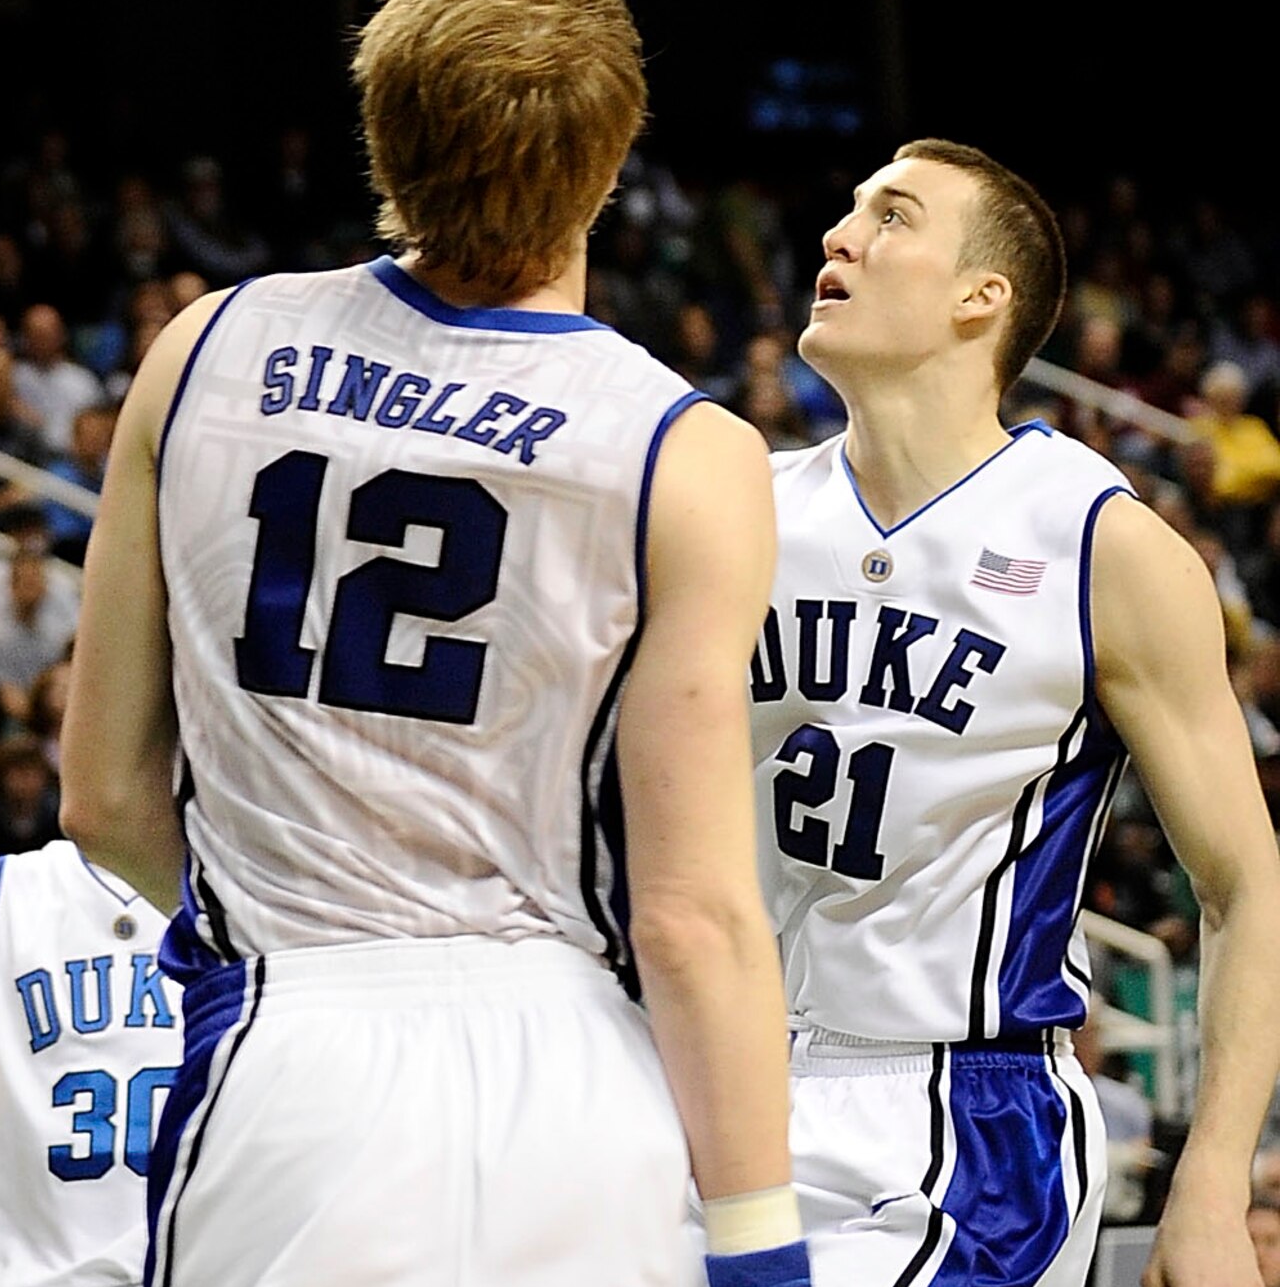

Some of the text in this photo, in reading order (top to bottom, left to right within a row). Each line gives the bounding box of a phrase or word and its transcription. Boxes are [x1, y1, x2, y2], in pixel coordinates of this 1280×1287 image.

[260, 345, 568, 466] SINGLER
[233, 449, 508, 725] 12
[750, 599, 1007, 735] DUKE
[773, 722, 895, 881] 21
